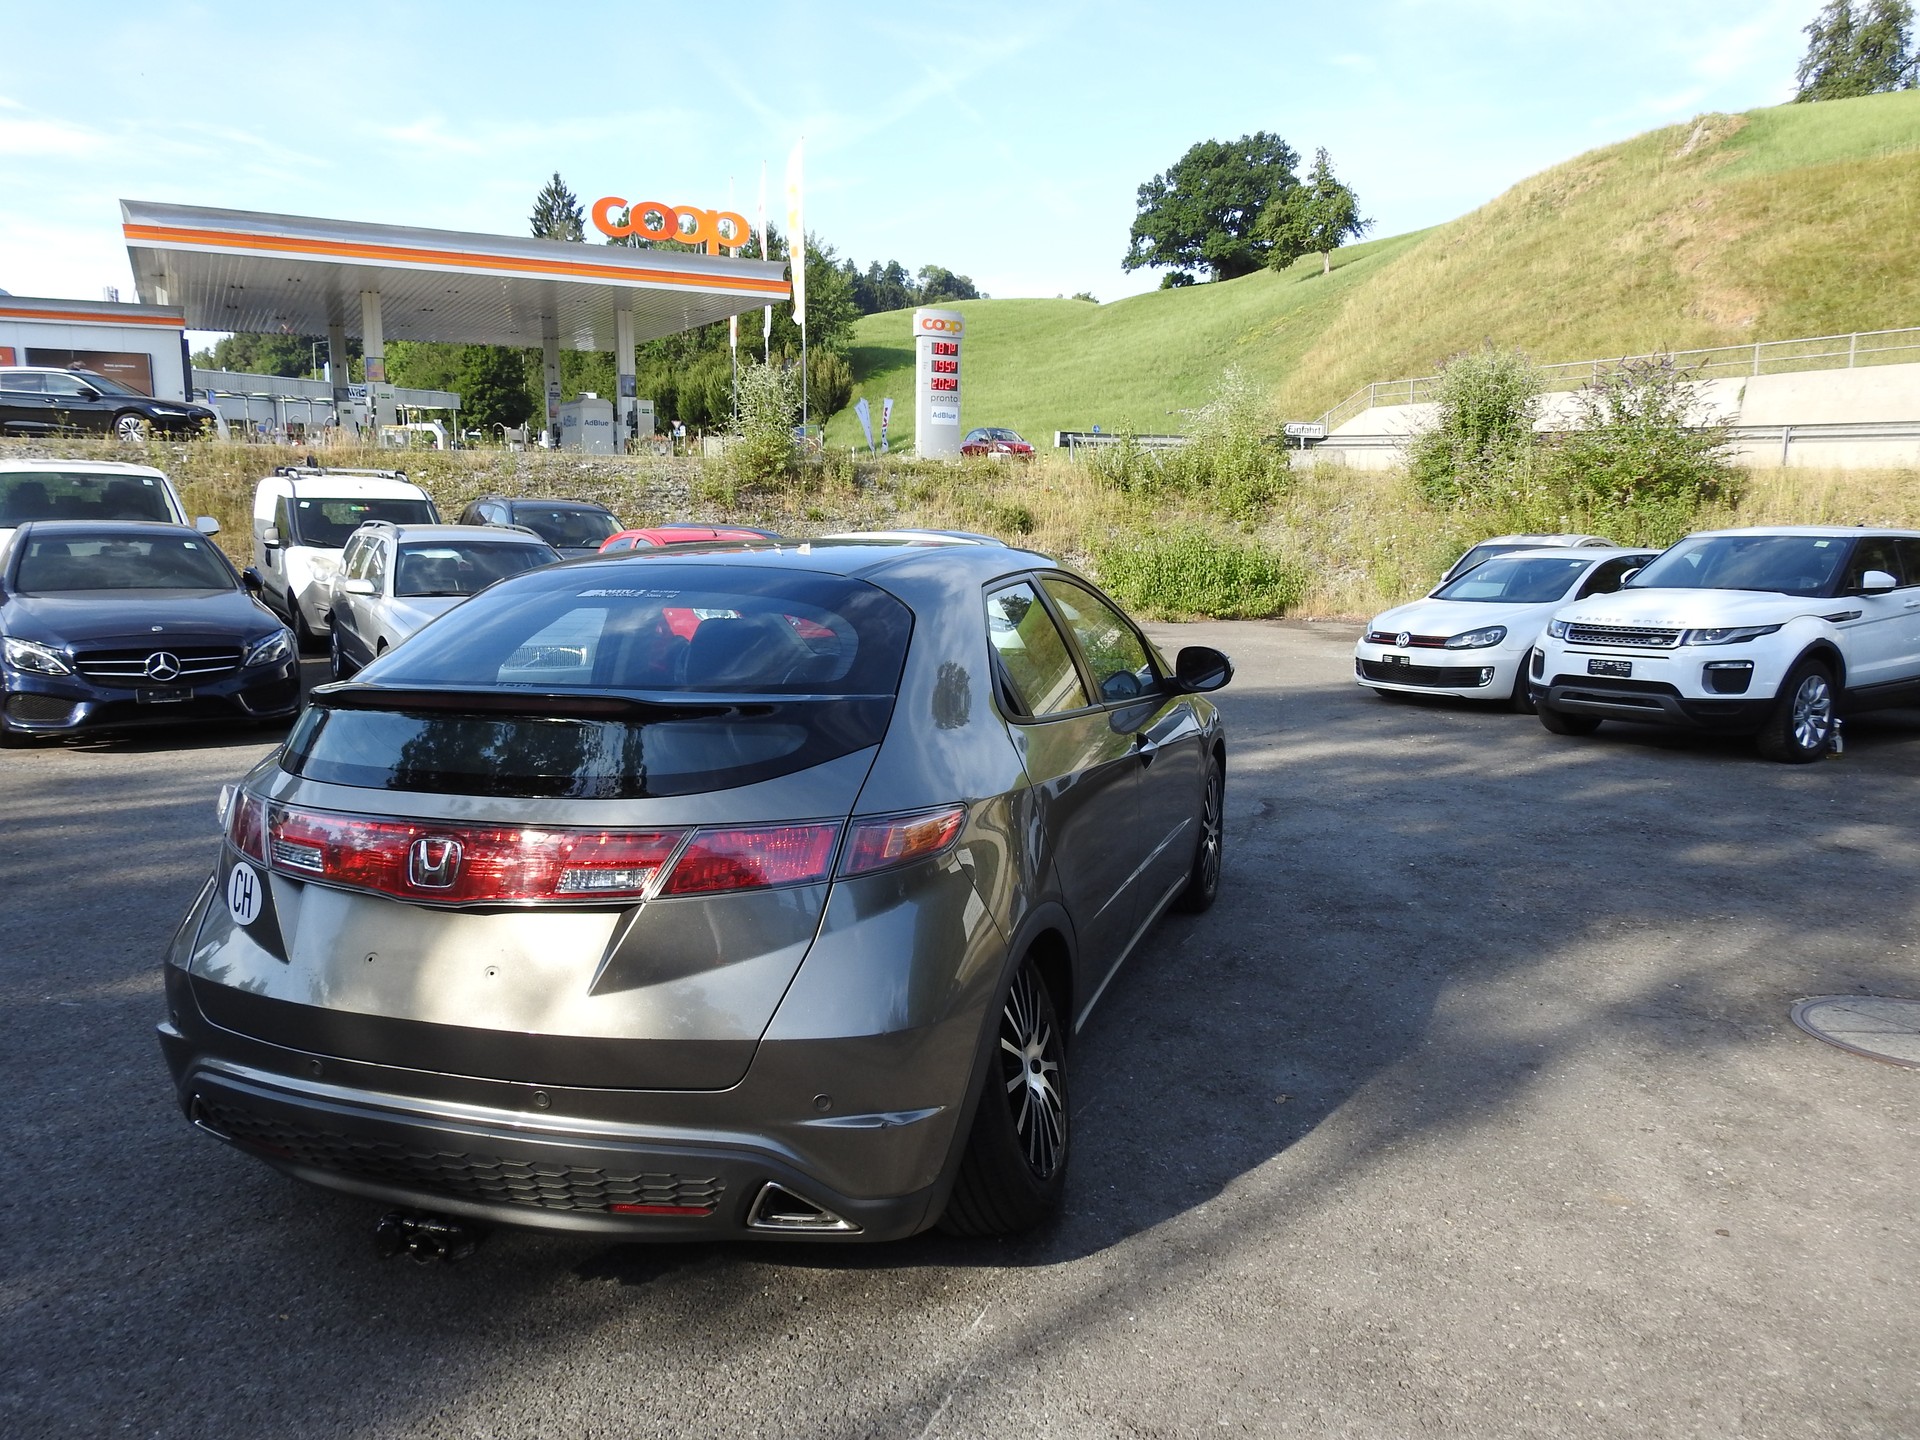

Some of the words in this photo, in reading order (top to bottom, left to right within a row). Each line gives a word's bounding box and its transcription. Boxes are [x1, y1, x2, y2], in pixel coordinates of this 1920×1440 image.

[592, 197, 750, 256] coop
[922, 318, 963, 335] coop
[930, 395, 958, 403] pronto
[1288, 425, 1321, 434] Einfahrt
[233, 869, 254, 919] CH
